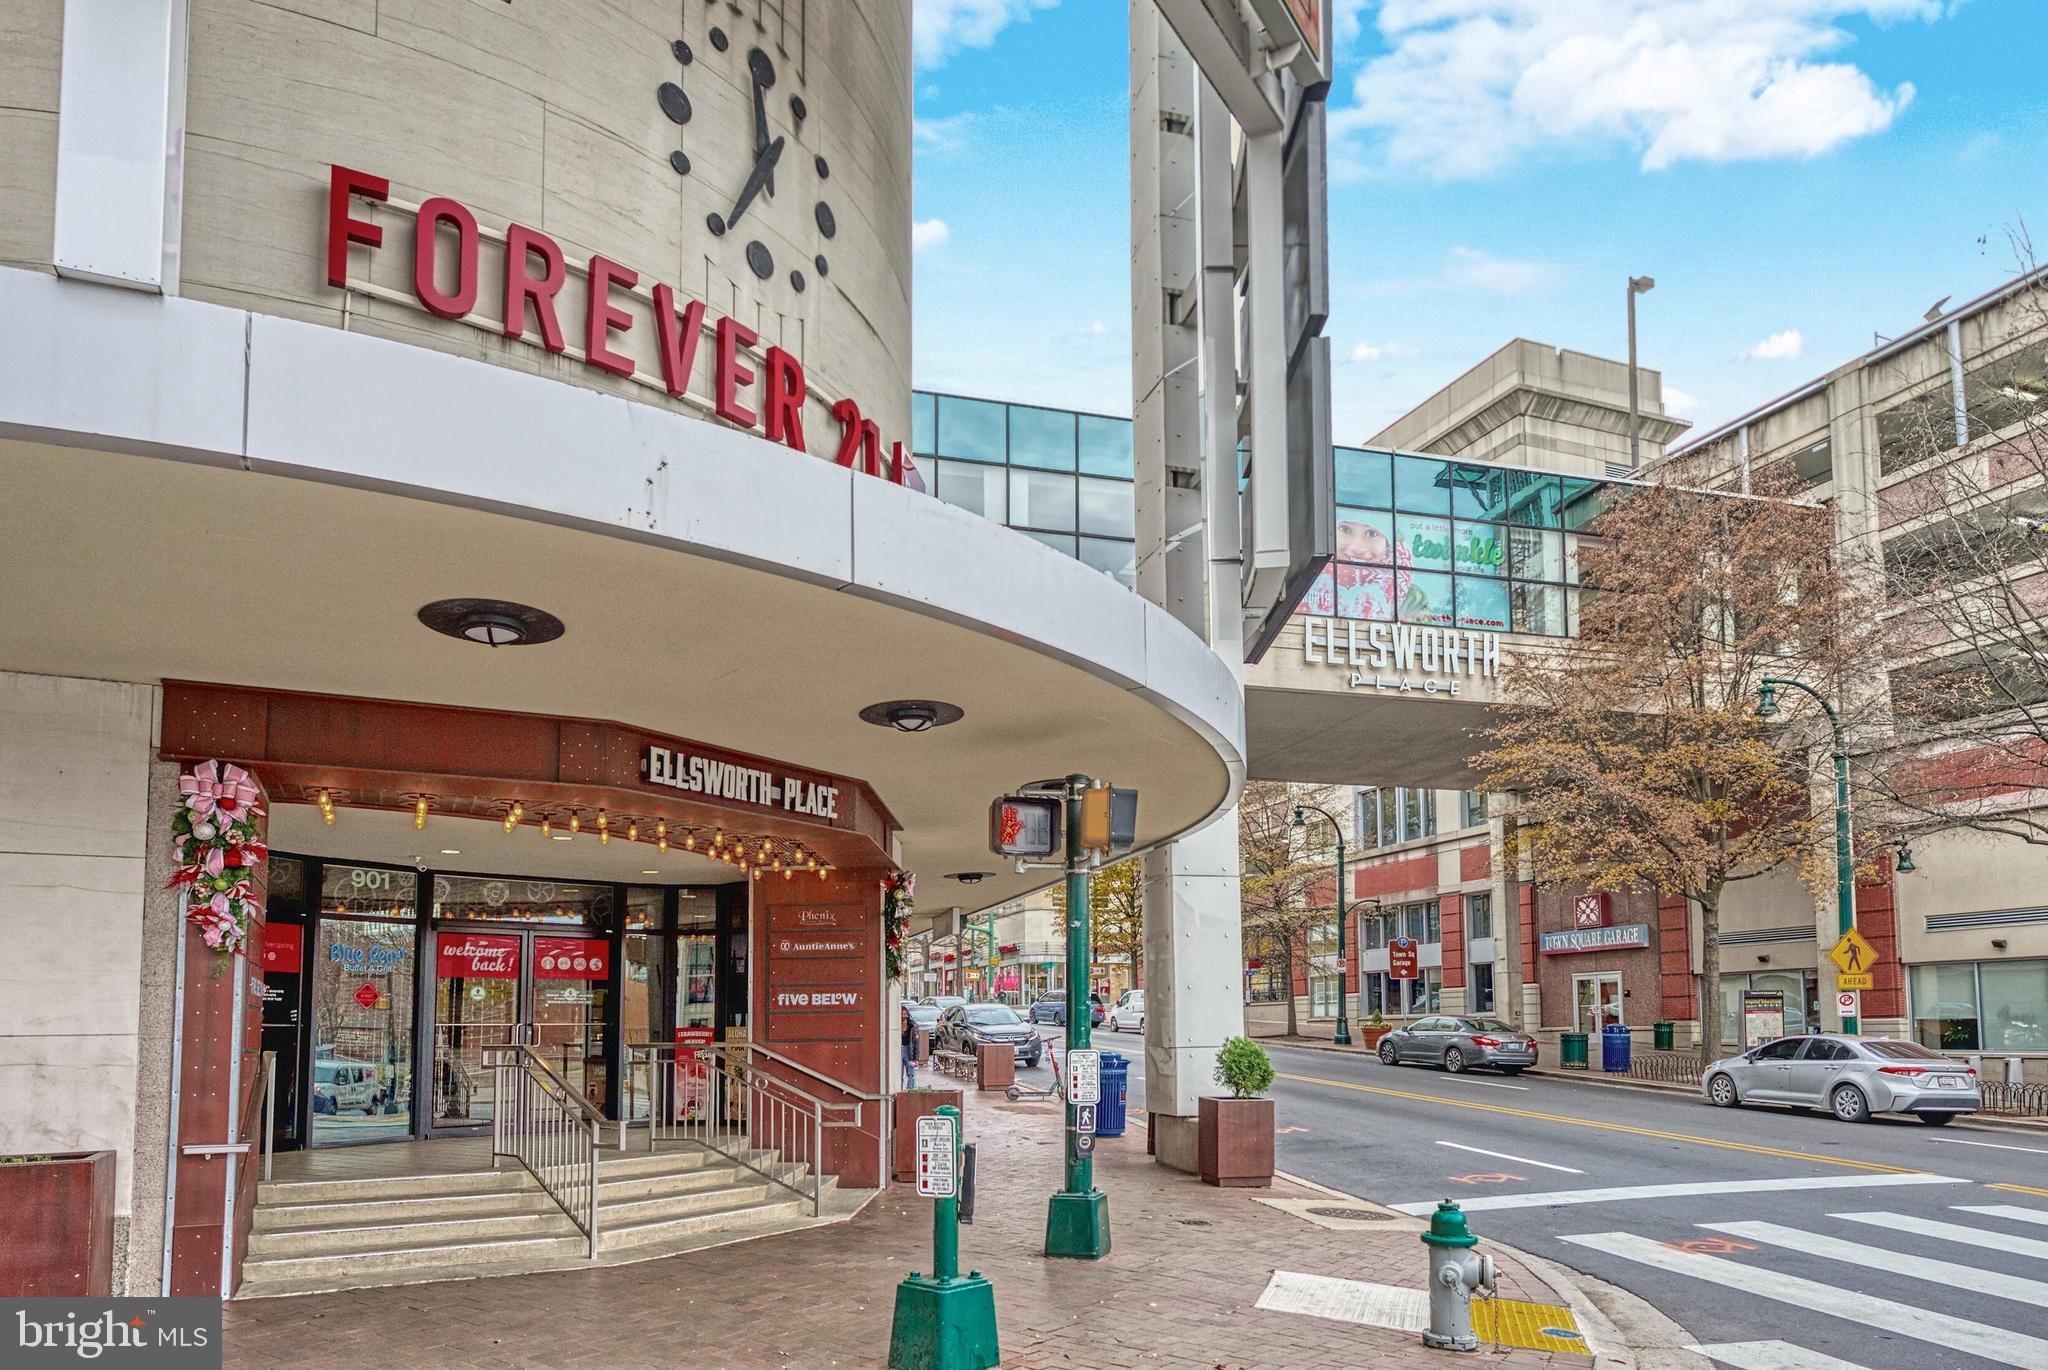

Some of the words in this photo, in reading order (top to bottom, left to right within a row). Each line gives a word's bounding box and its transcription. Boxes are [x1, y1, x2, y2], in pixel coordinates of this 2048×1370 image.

[328, 164, 807, 453] FOREVER
[1455, 527, 1473, 536] more
[1412, 533, 1505, 566] twinkle
[1474, 565, 1485, 574] life
[1305, 616, 1500, 678] ELLSWORTH
[1350, 672, 1461, 696] PLACE
[650, 746, 772, 806] ELLSWORTH
[784, 777, 838, 820] PLACE
[351, 869, 390, 890] 901
[798, 910, 837, 922] Phenix
[1544, 933, 1569, 951] TOWN
[1570, 931, 1602, 951] SQUARE
[1604, 927, 1640, 946] GARAGE
[329, 943, 364, 963] Blue
[443, 942, 507, 957] welcome
[471, 957, 514, 972] back!
[1392, 959, 1411, 967] Garage
[1843, 977, 1867, 985] AHEAD
[777, 993, 809, 1006] five
[677, 1030, 714, 1038] STRAWBERRY
